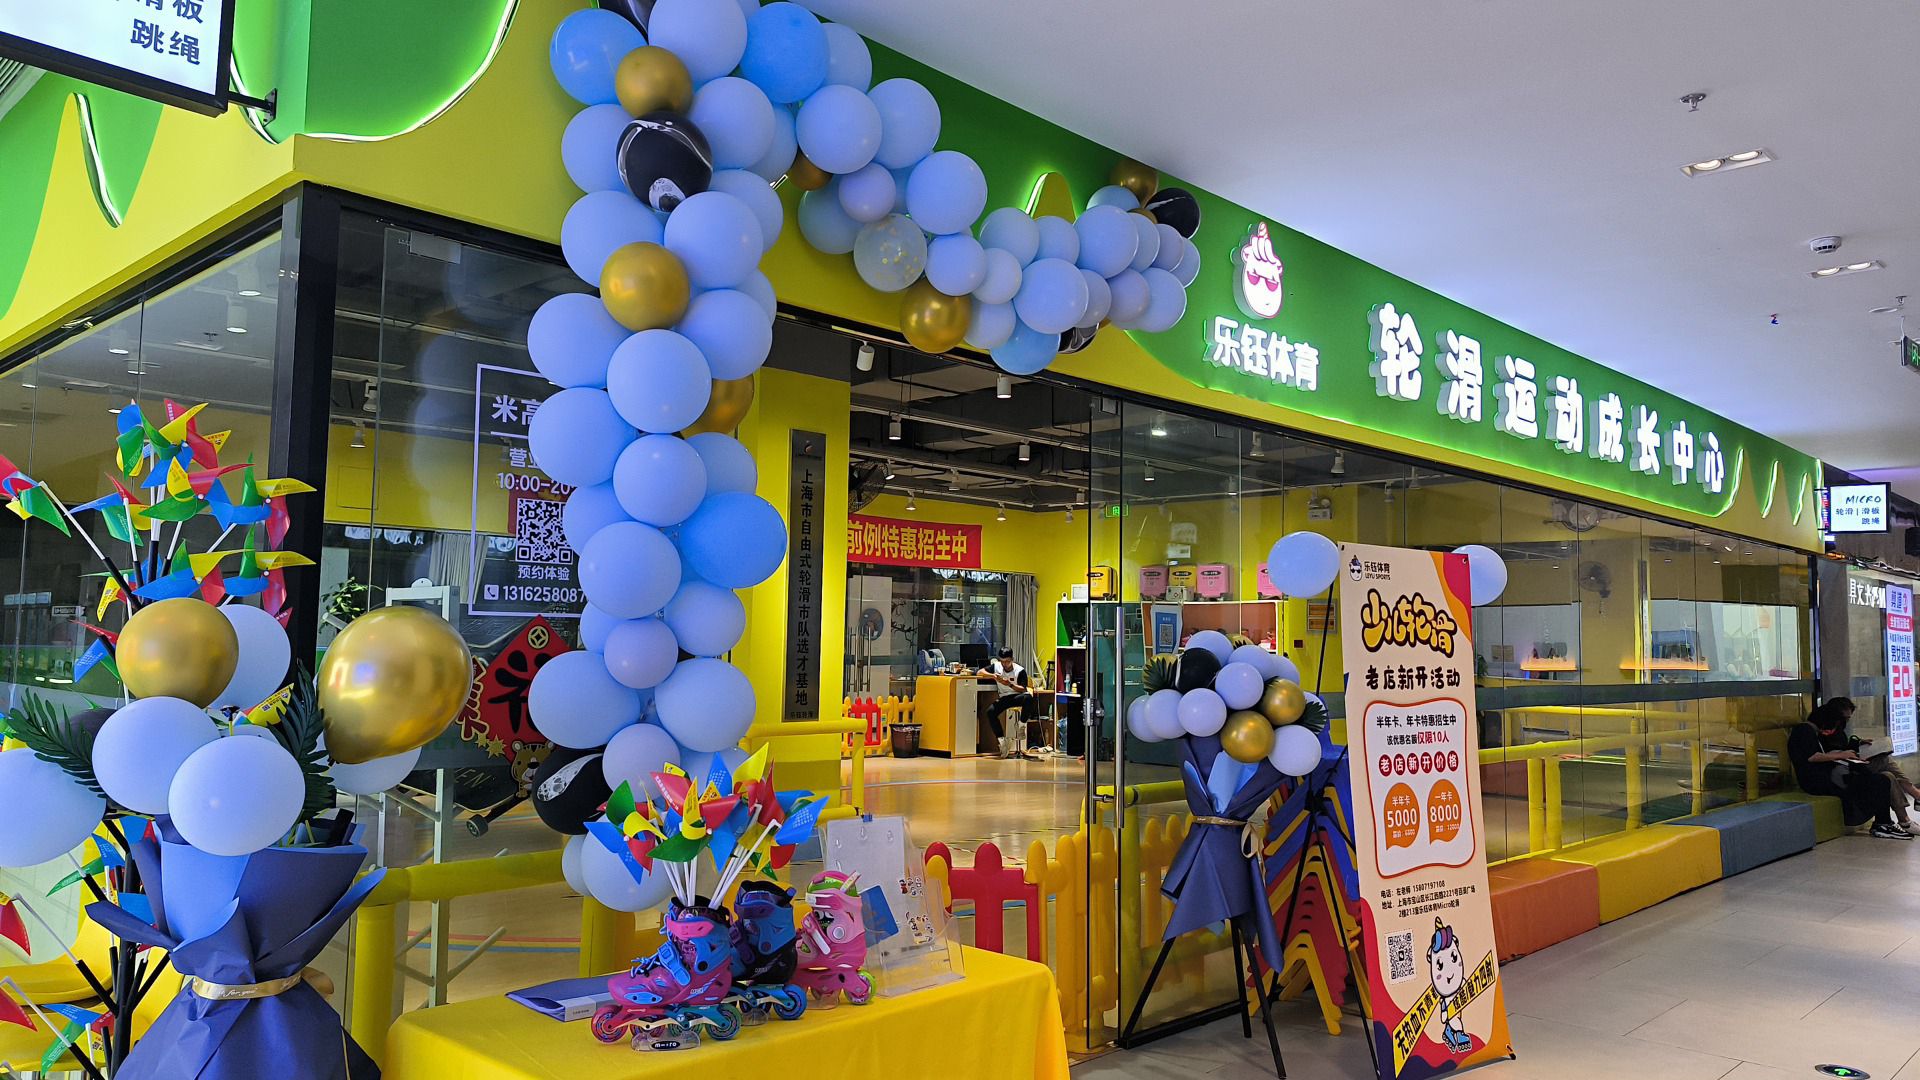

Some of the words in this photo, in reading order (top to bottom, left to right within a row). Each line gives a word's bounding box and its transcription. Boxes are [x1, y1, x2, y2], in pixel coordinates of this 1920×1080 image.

[130, 18, 200, 65] 跳绳
[1206, 315, 1321, 392] 乐钰体育
[1370, 302, 1726, 494] 轮滑运动成长中心
[1845, 495, 1882, 505] MICRO
[1861, 517, 1880, 525] 跳绳
[517, 564, 570, 581] 预约体验
[1363, 560, 1390, 574] 乐钰体育
[794, 468, 813, 706] 上海市自由式轮滑市队选才基地
[1360, 588, 1458, 659] 少儿轮滑
[1365, 664, 1461, 690] 老店新开活动
[1376, 713, 1457, 728] 半年卡、年卡特惠招生中
[1386, 731, 1450, 745] 该优惠名额仅限10人
[1379, 752, 1458, 774] 老店新开价格
[1391, 795, 1411, 807] 半年卡
[1434, 790, 1453, 801] 一年卡
[1387, 808, 1417, 828] 5000
[1430, 803, 1459, 823] 8000
